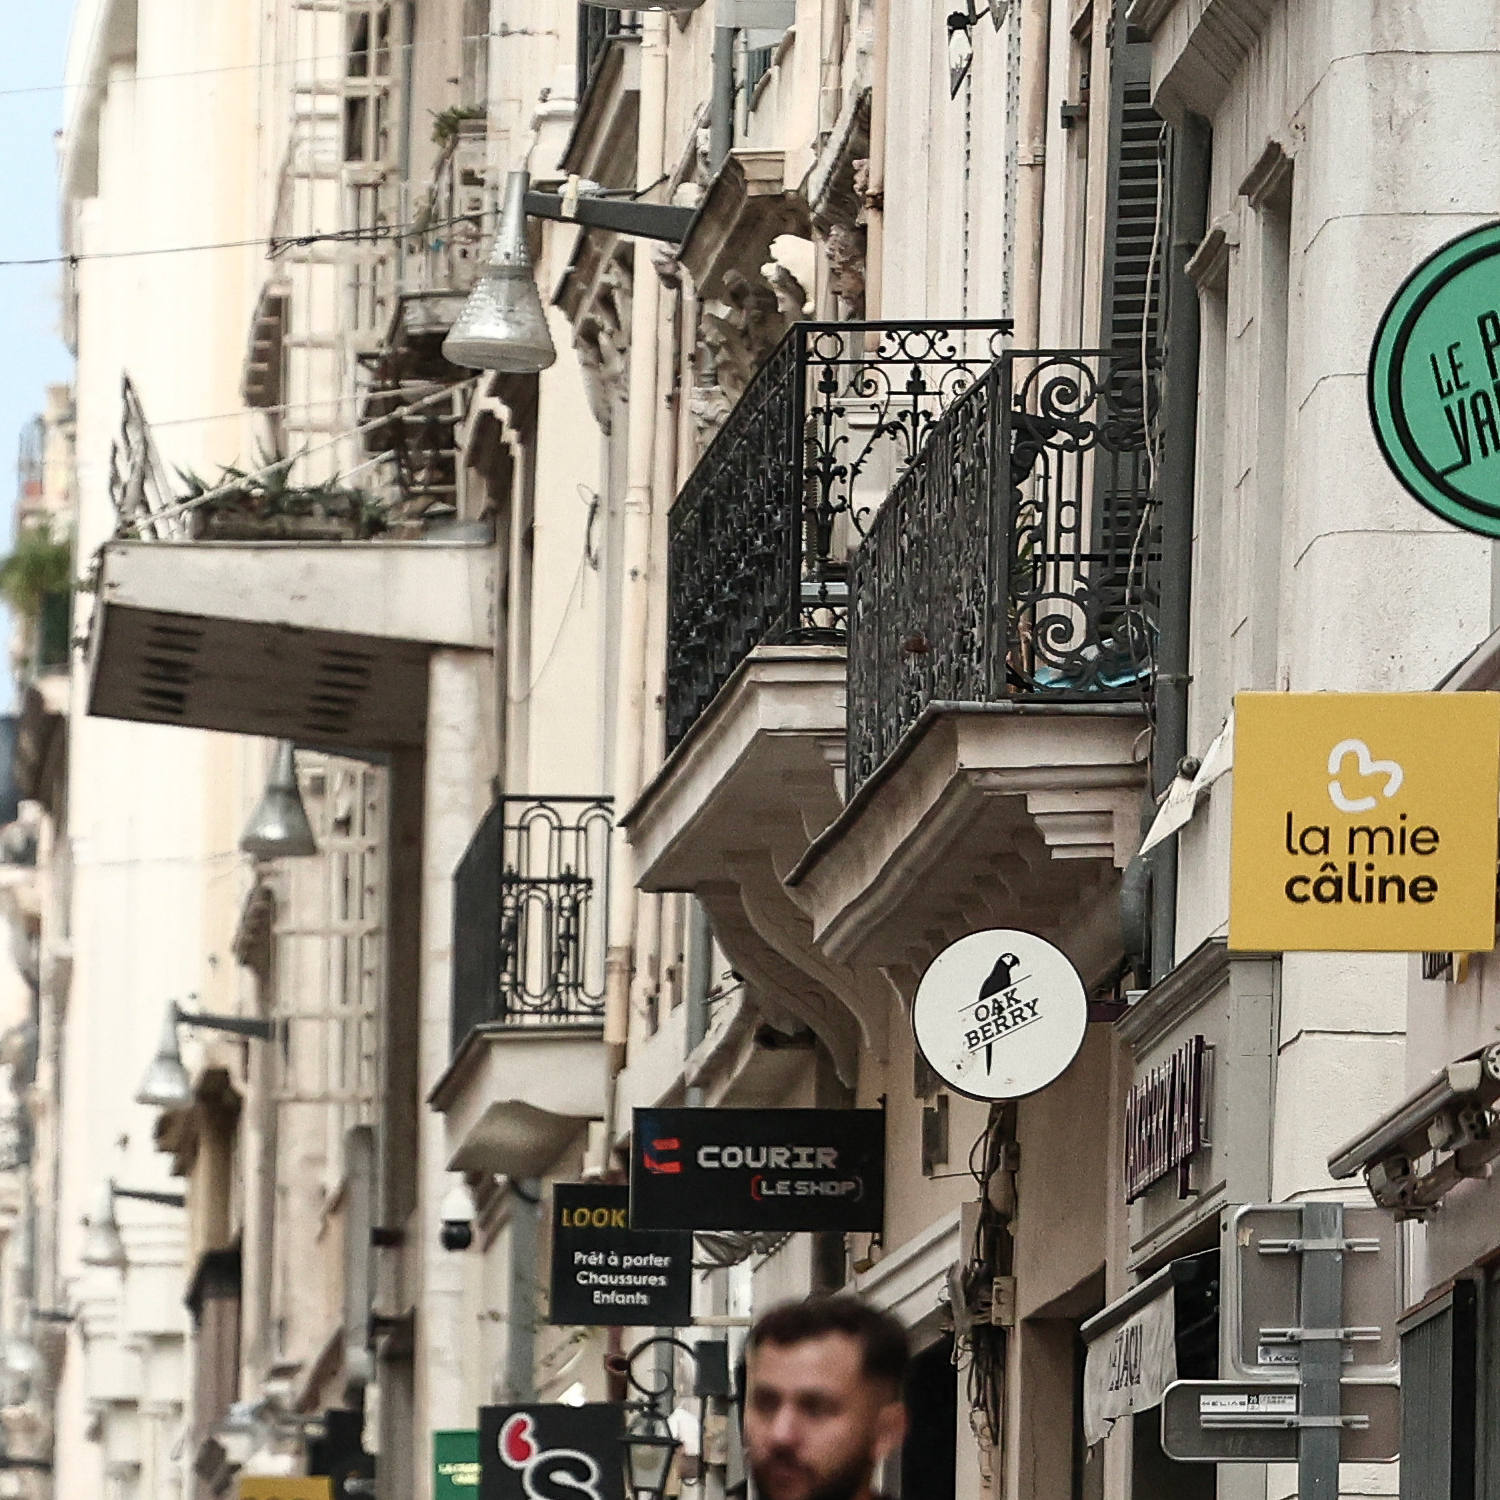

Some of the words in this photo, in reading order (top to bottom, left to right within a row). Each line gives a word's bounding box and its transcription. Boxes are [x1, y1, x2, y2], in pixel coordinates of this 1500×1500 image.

[1429, 341, 1470, 400] LE
[1443, 388, 1500, 464] VA
[1286, 811, 1330, 856] la
[1348, 813, 1440, 856] mie
[1285, 860, 1438, 904] câline
[974, 987, 1022, 1022] OAK
[964, 997, 1039, 1050] BERRY
[696, 1145, 839, 1169] COURIR
[561, 1207, 627, 1228] LOOK
[573, 1251, 605, 1267] Prêt
[606, 1251, 618, 1267] à
[622, 1254, 671, 1269] porter
[576, 1270, 668, 1287] Chaussures
[592, 1290, 649, 1306] Enfants
